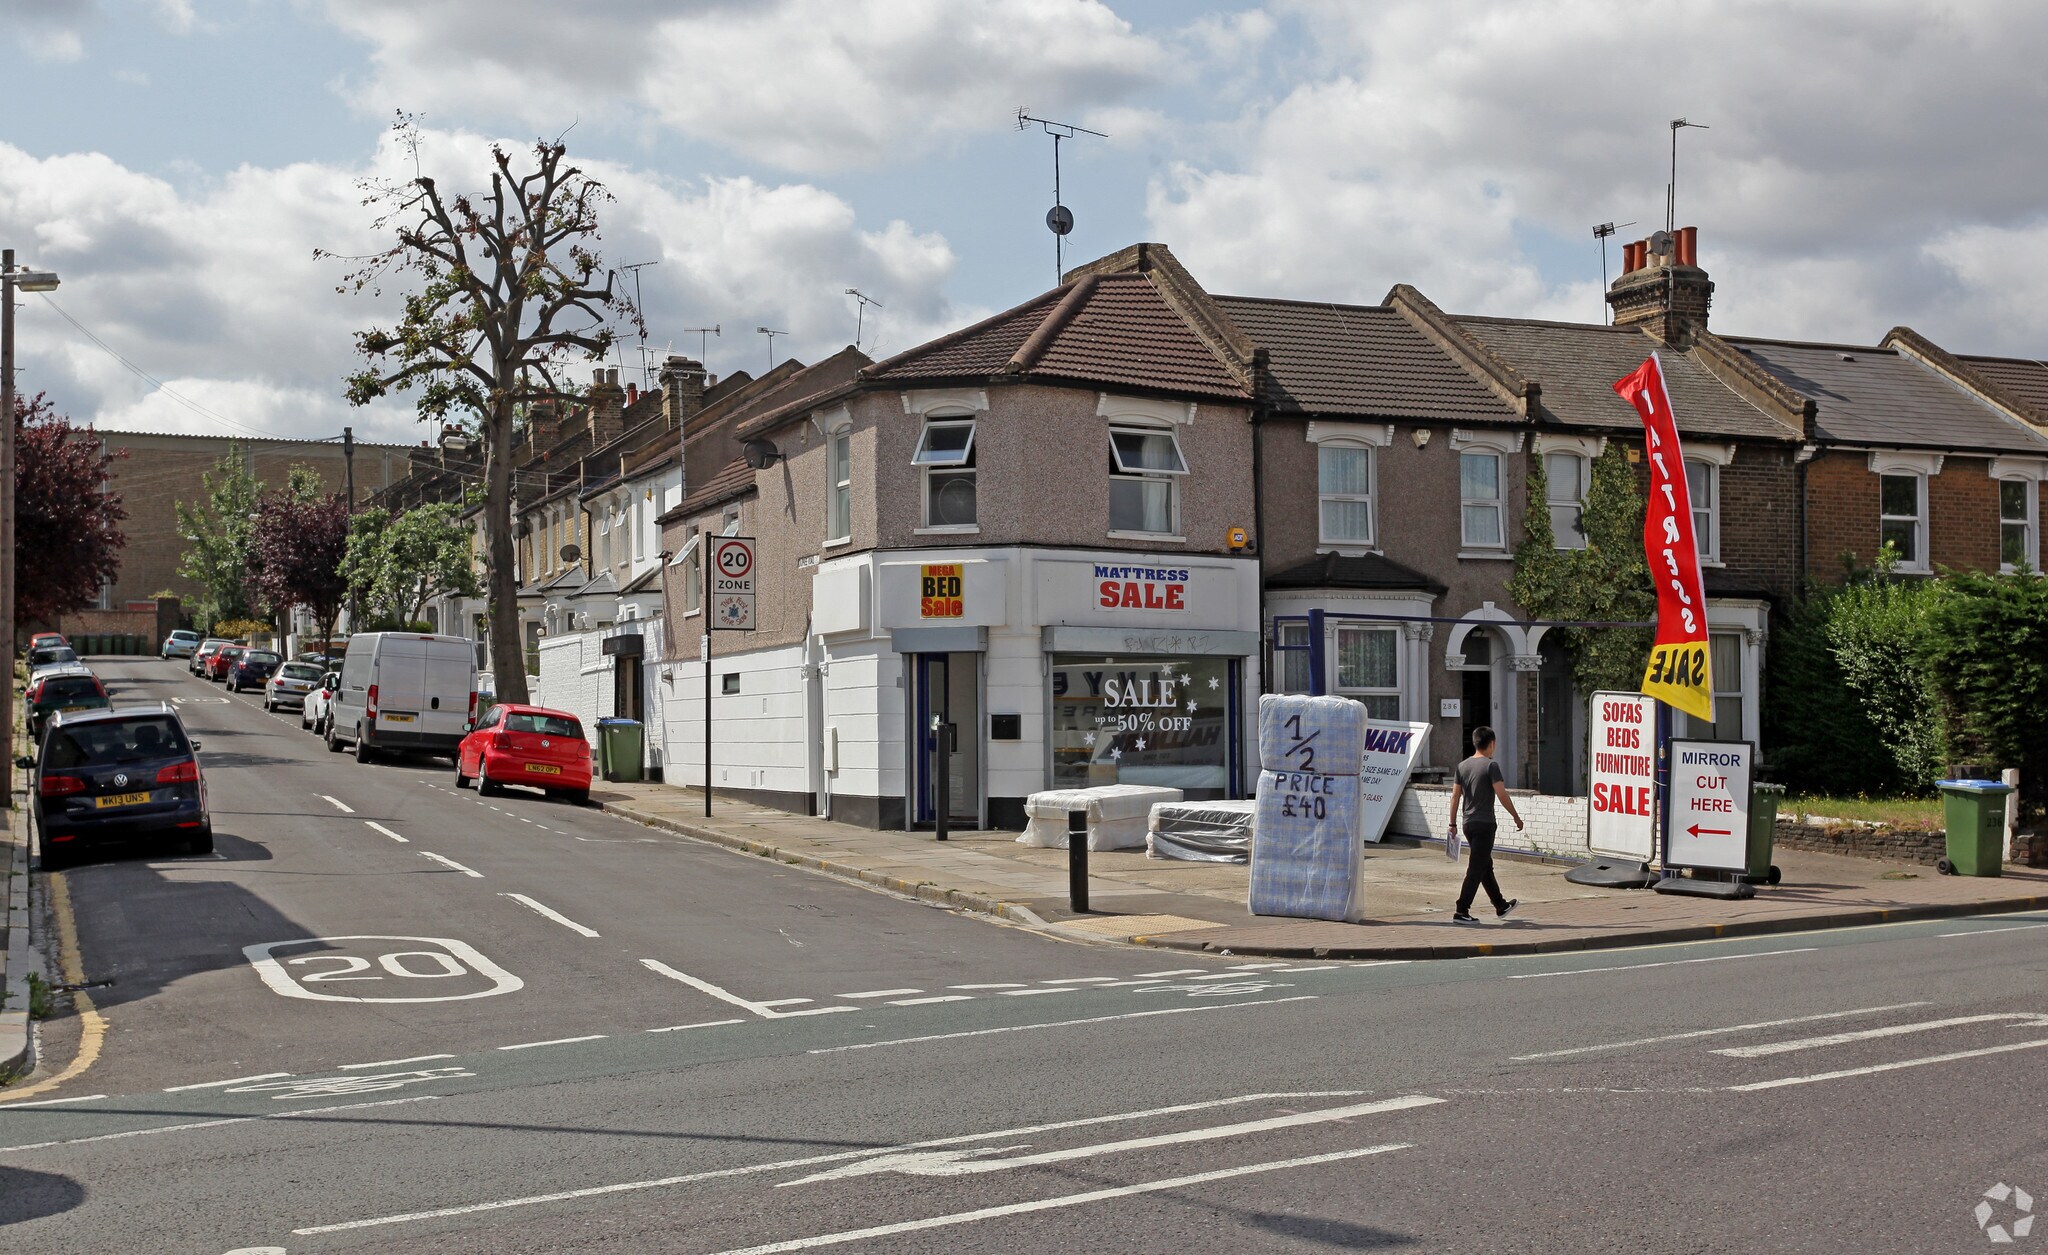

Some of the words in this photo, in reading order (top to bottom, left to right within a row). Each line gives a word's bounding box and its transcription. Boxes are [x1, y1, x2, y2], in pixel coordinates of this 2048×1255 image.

[723, 552, 747, 567] 20
[928, 565, 955, 576] MEGA
[1094, 566, 1189, 581] MATTRESS
[718, 580, 750, 590] ZONE
[922, 576, 961, 597] BED
[1100, 581, 1184, 610] SALE
[921, 597, 963, 616] Sale
[1104, 679, 1177, 708] SALE
[1095, 716, 1106, 724] up
[1117, 712, 1156, 732] 50%
[1159, 716, 1193, 731] OFF
[1602, 702, 1642, 724] SOFAS
[1607, 727, 1640, 749] BEDS
[1596, 752, 1650, 777] FURNITURE
[1682, 752, 1741, 766] MIRROR
[1365, 766, 1376, 774] SIZE
[1376, 767, 1391, 776] SAME
[1391, 768, 1403, 776] DAY
[1274, 773, 1334, 795] PRICE
[1696, 776, 1728, 790] CUT
[102, 795, 124, 806] WK13
[124, 793, 144, 804] UNS
[1282, 794, 1326, 820] £40
[1366, 794, 1383, 802] GLASS
[1593, 782, 1650, 816] SALE
[1690, 798, 1732, 812] HERE
[288, 951, 468, 982] 20
